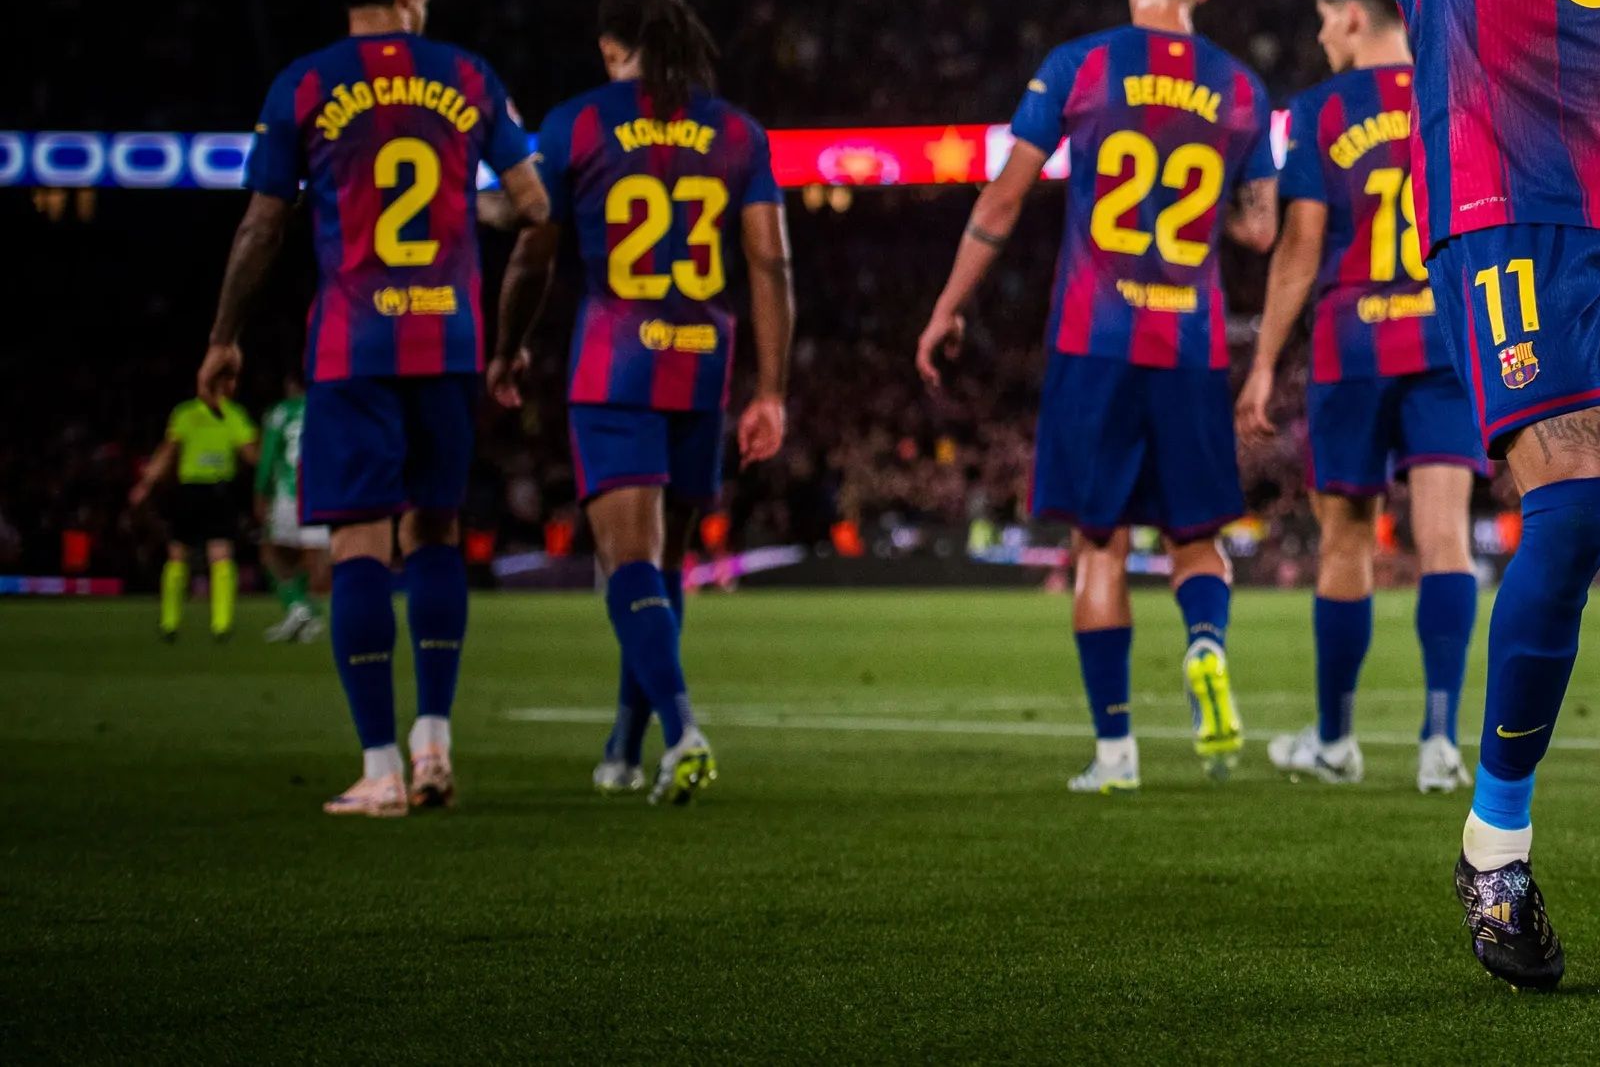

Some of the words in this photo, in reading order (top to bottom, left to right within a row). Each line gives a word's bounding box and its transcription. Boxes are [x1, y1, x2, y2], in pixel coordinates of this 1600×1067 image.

[316, 82, 376, 140] JOÃO
[373, 76, 479, 133] CANCELO
[1124, 75, 1222, 123] BERNAL
[374, 137, 441, 266] 2
[606, 174, 729, 301] 23
[1090, 130, 1225, 267] 22
[1475, 259, 1539, 346] 11
